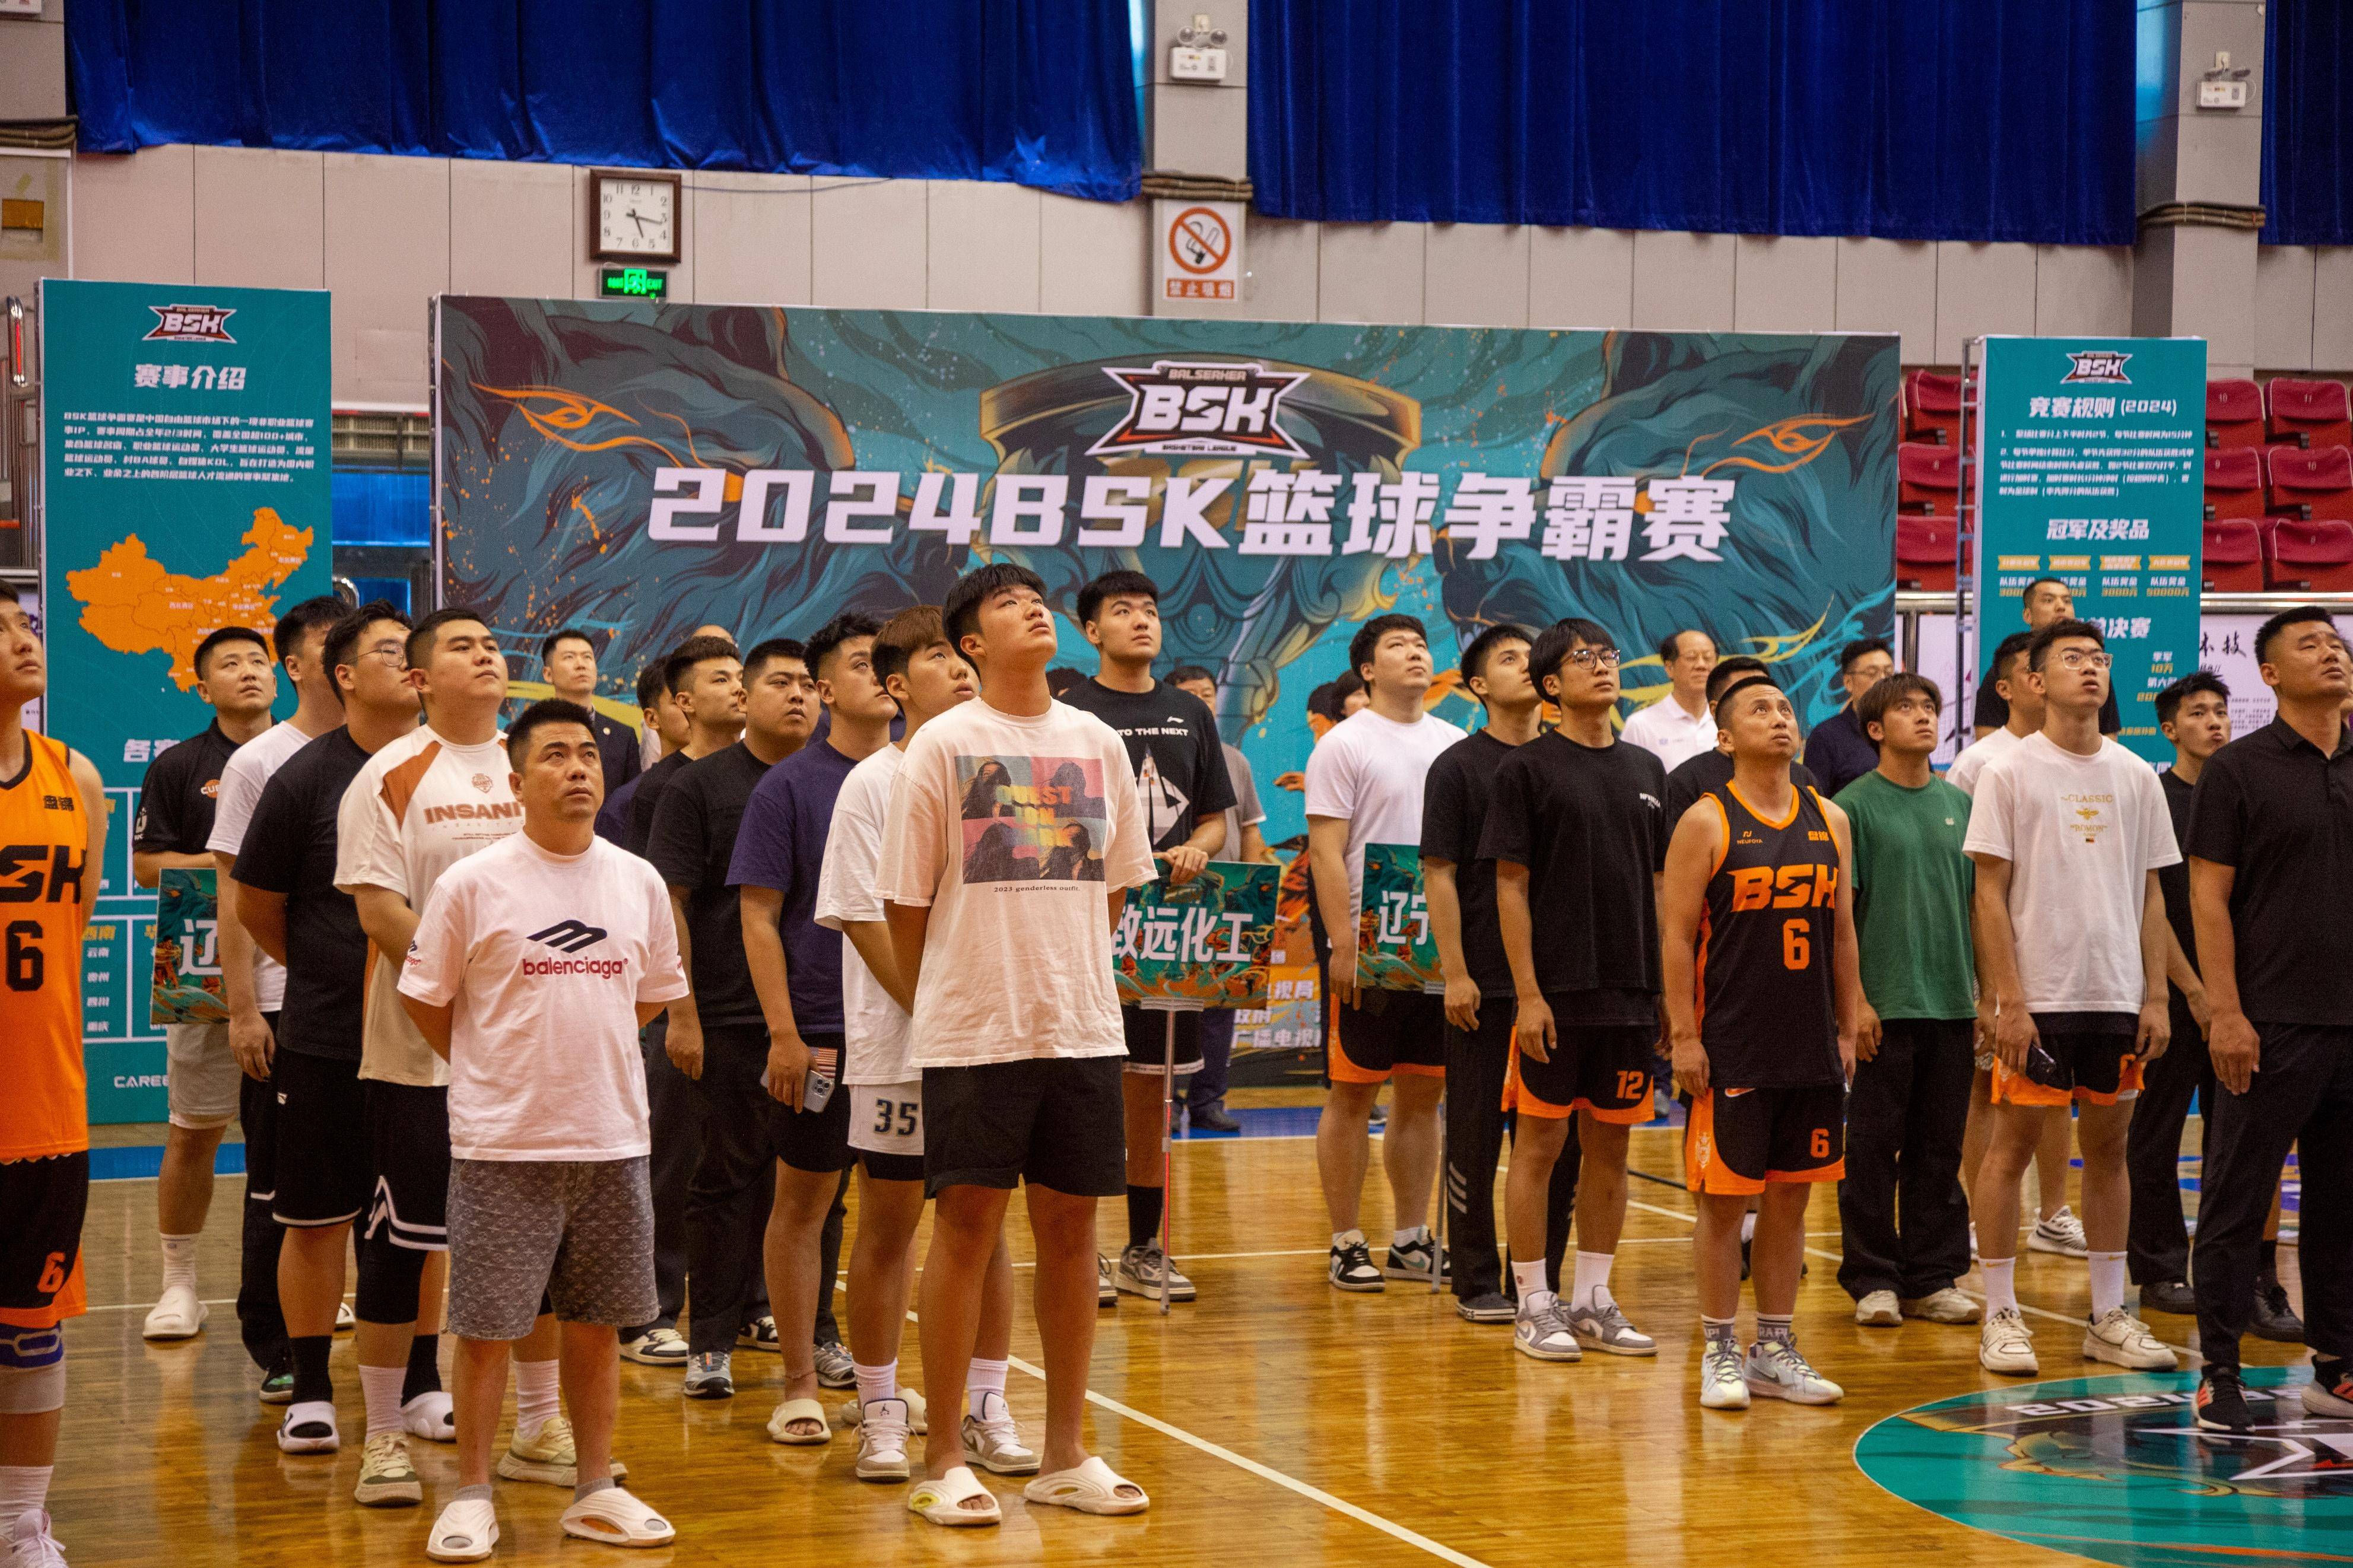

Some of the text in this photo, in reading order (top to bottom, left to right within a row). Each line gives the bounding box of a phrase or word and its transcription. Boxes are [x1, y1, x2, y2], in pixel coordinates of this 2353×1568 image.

[604, 193, 612, 203] 10
[631, 185, 640, 195] 12
[661, 196, 667, 206] 2
[617, 237, 623, 247] 7
[632, 238, 639, 249] 6
[648, 239, 655, 249] 5
[661, 230, 666, 240] 4
[1169, 280, 1233, 298] 禁止吸烟
[163, 313, 222, 333] BSK
[134, 363, 246, 390] 赛事介绍
[2076, 359, 2122, 376] BSK
[1135, 384, 1276, 433] BSK
[2029, 396, 2177, 418] 竞赛规则 (2024)
[648, 467, 1735, 561] 2024BSK篮球争霸赛
[2047, 519, 2149, 540] 冠军及奖品
[1135, 727, 1160, 736] THE
[1161, 727, 1189, 736] NEXT
[1727, 863, 1839, 912] BSK
[1783, 918, 1809, 970] 6
[6, 920, 44, 991] 6
[522, 957, 623, 979] balenciaga
[1616, 1071, 1644, 1100] 12
[874, 1097, 917, 1137] 35
[1810, 1128, 1830, 1158] 6
[37, 1252, 65, 1293] 6
